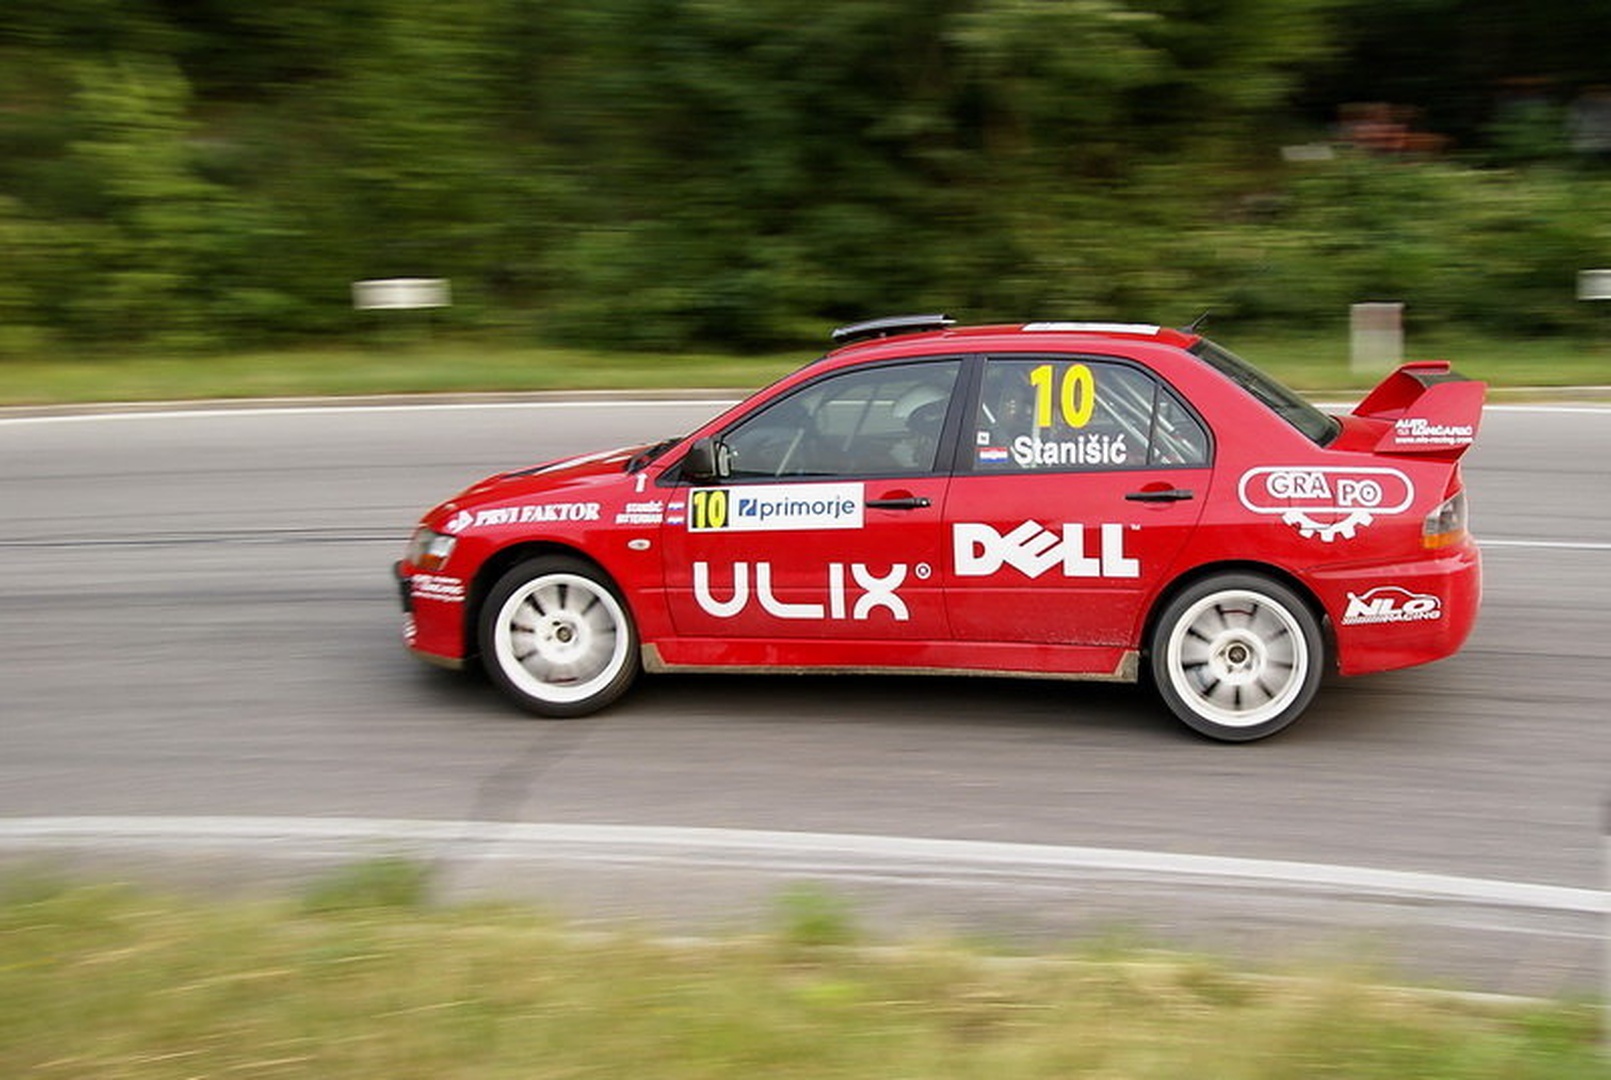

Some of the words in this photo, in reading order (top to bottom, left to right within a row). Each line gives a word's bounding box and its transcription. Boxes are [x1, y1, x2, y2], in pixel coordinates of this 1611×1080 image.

[1030, 363, 1095, 428] 10
[1013, 433, 1127, 465] Stanišić
[1268, 473, 1329, 496] GRA
[1340, 481, 1380, 504] PO
[475, 505, 519, 527] PRVI
[519, 502, 600, 523] FAKTOR
[694, 491, 727, 529] 10
[760, 495, 856, 520] primorje
[953, 519, 1140, 579] DELL
[692, 561, 910, 621] ULIX
[1344, 592, 1437, 617] NLO
